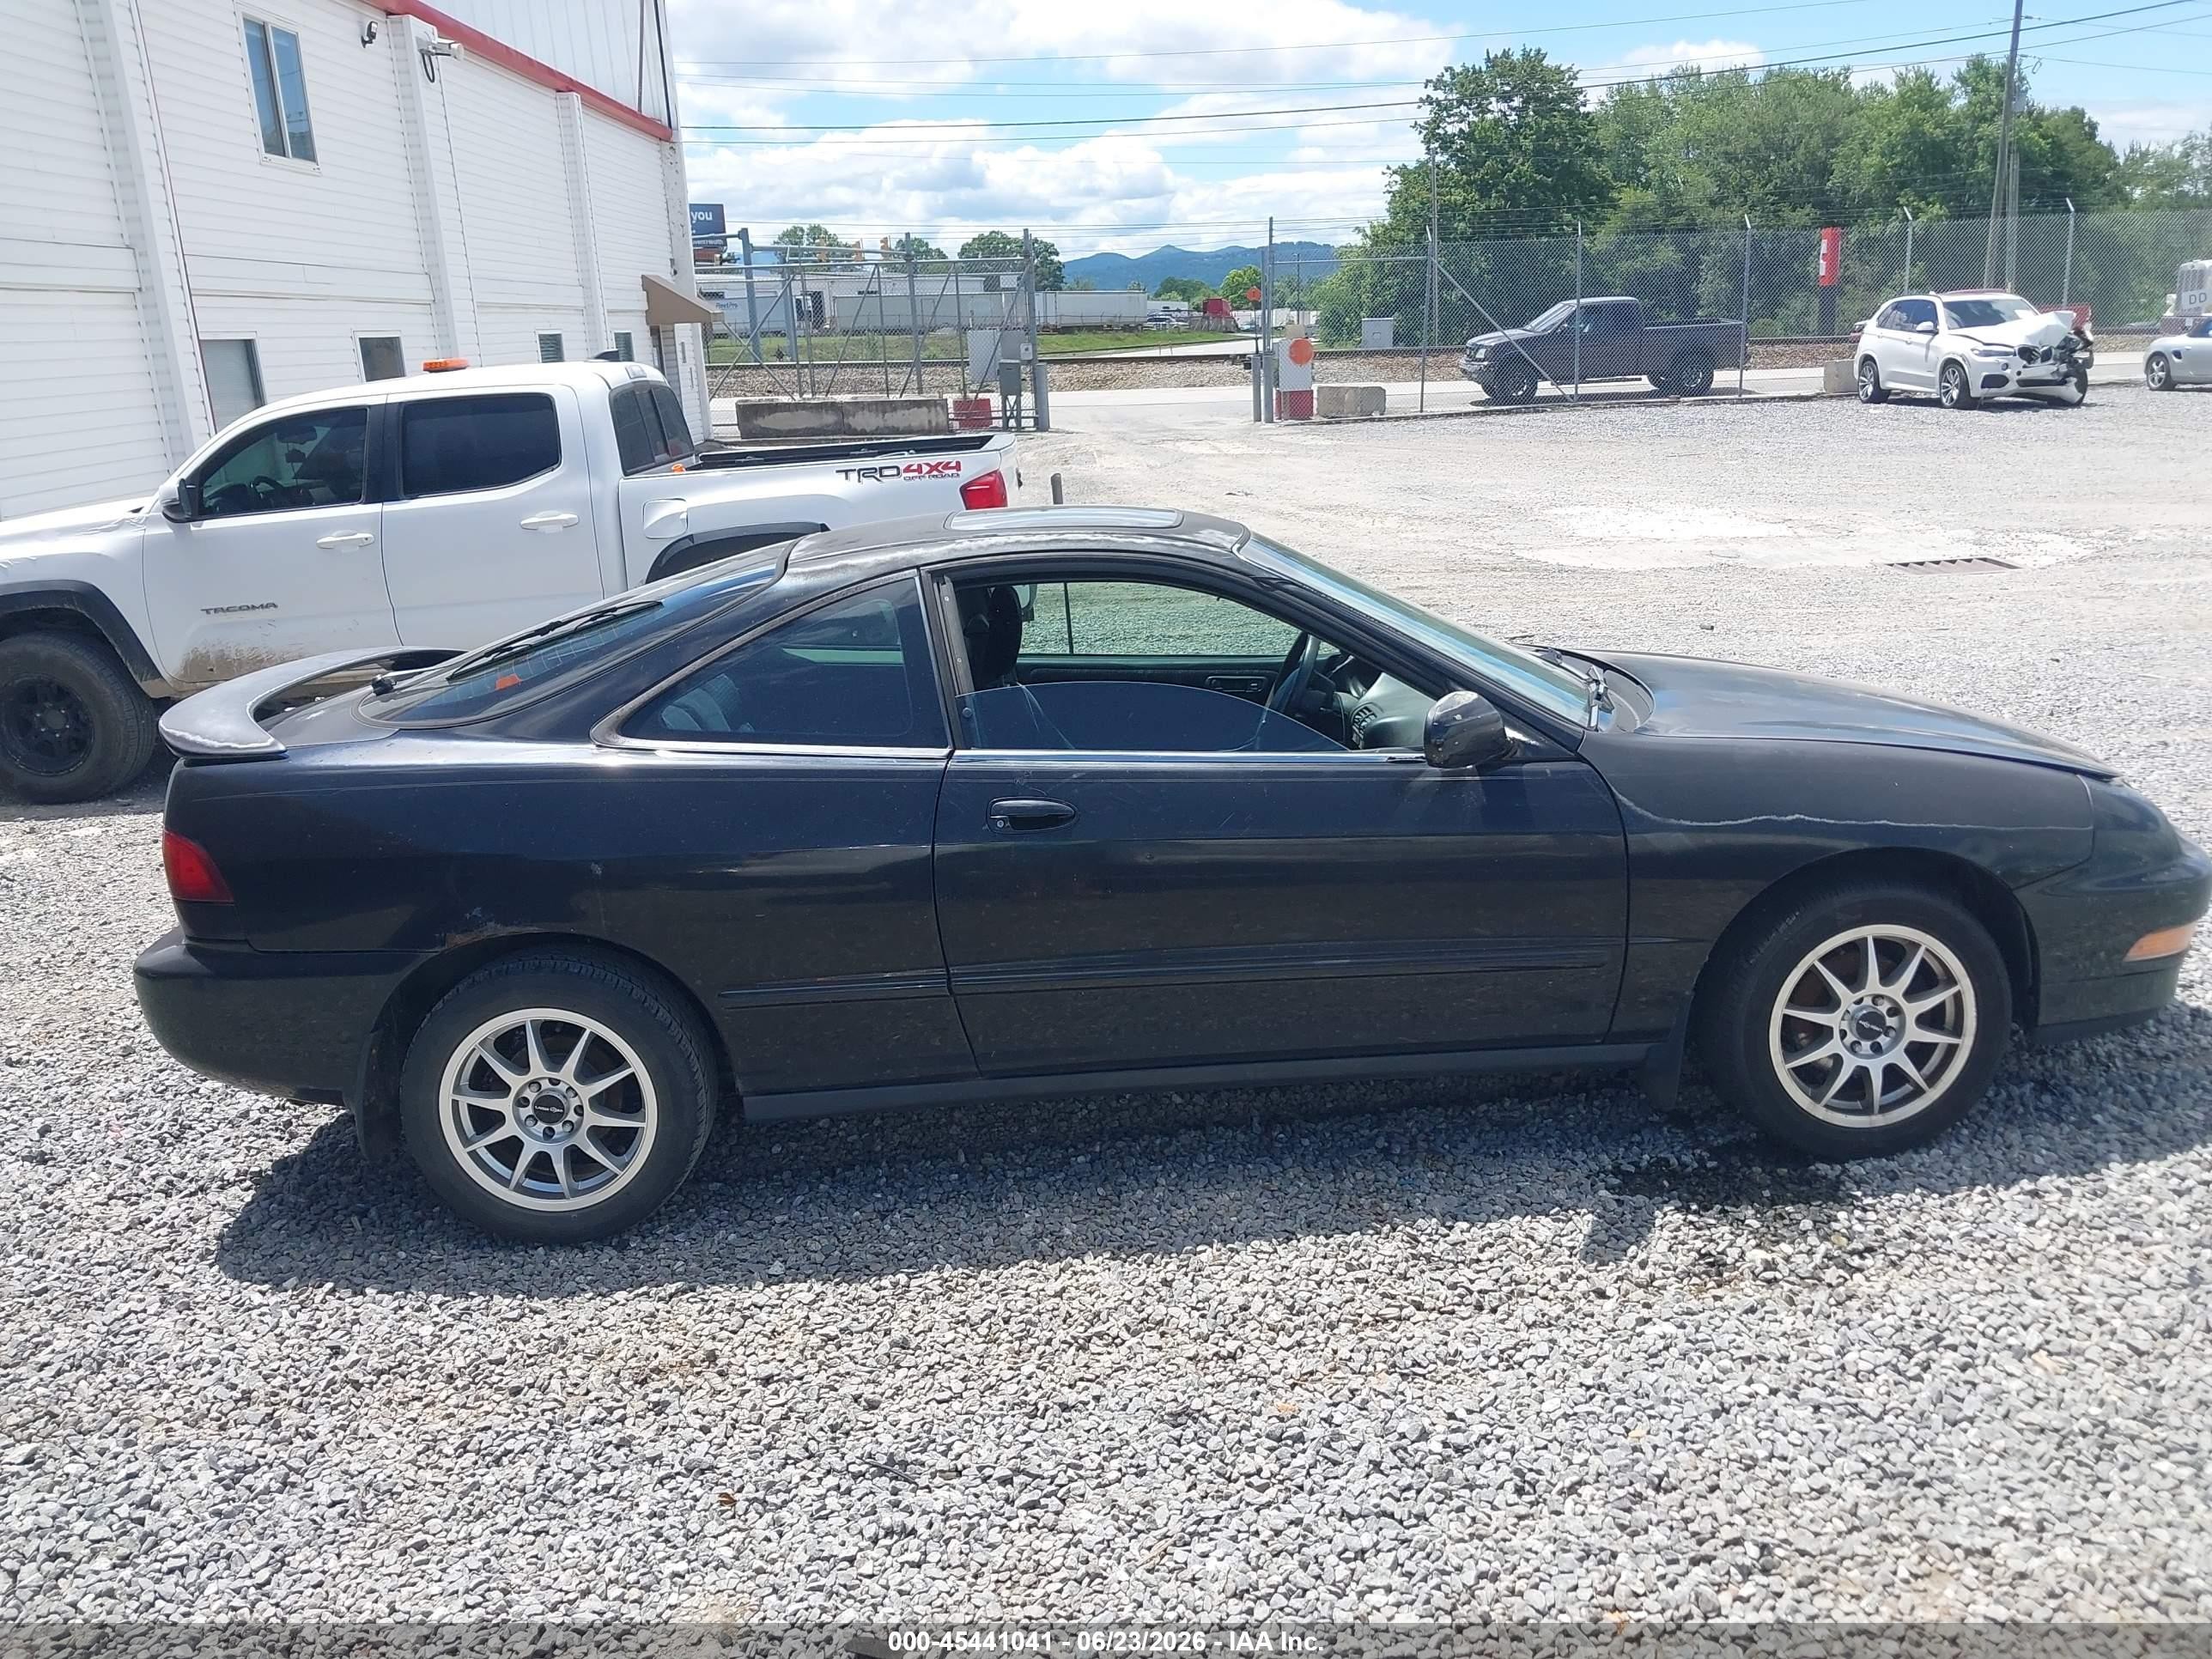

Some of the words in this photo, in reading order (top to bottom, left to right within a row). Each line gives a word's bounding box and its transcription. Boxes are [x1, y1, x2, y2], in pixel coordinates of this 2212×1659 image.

[690, 211, 713, 223] you
[836, 465, 902, 483] TRD
[929, 472, 961, 481] ROAD
[200, 602, 279, 615] TACOMA
